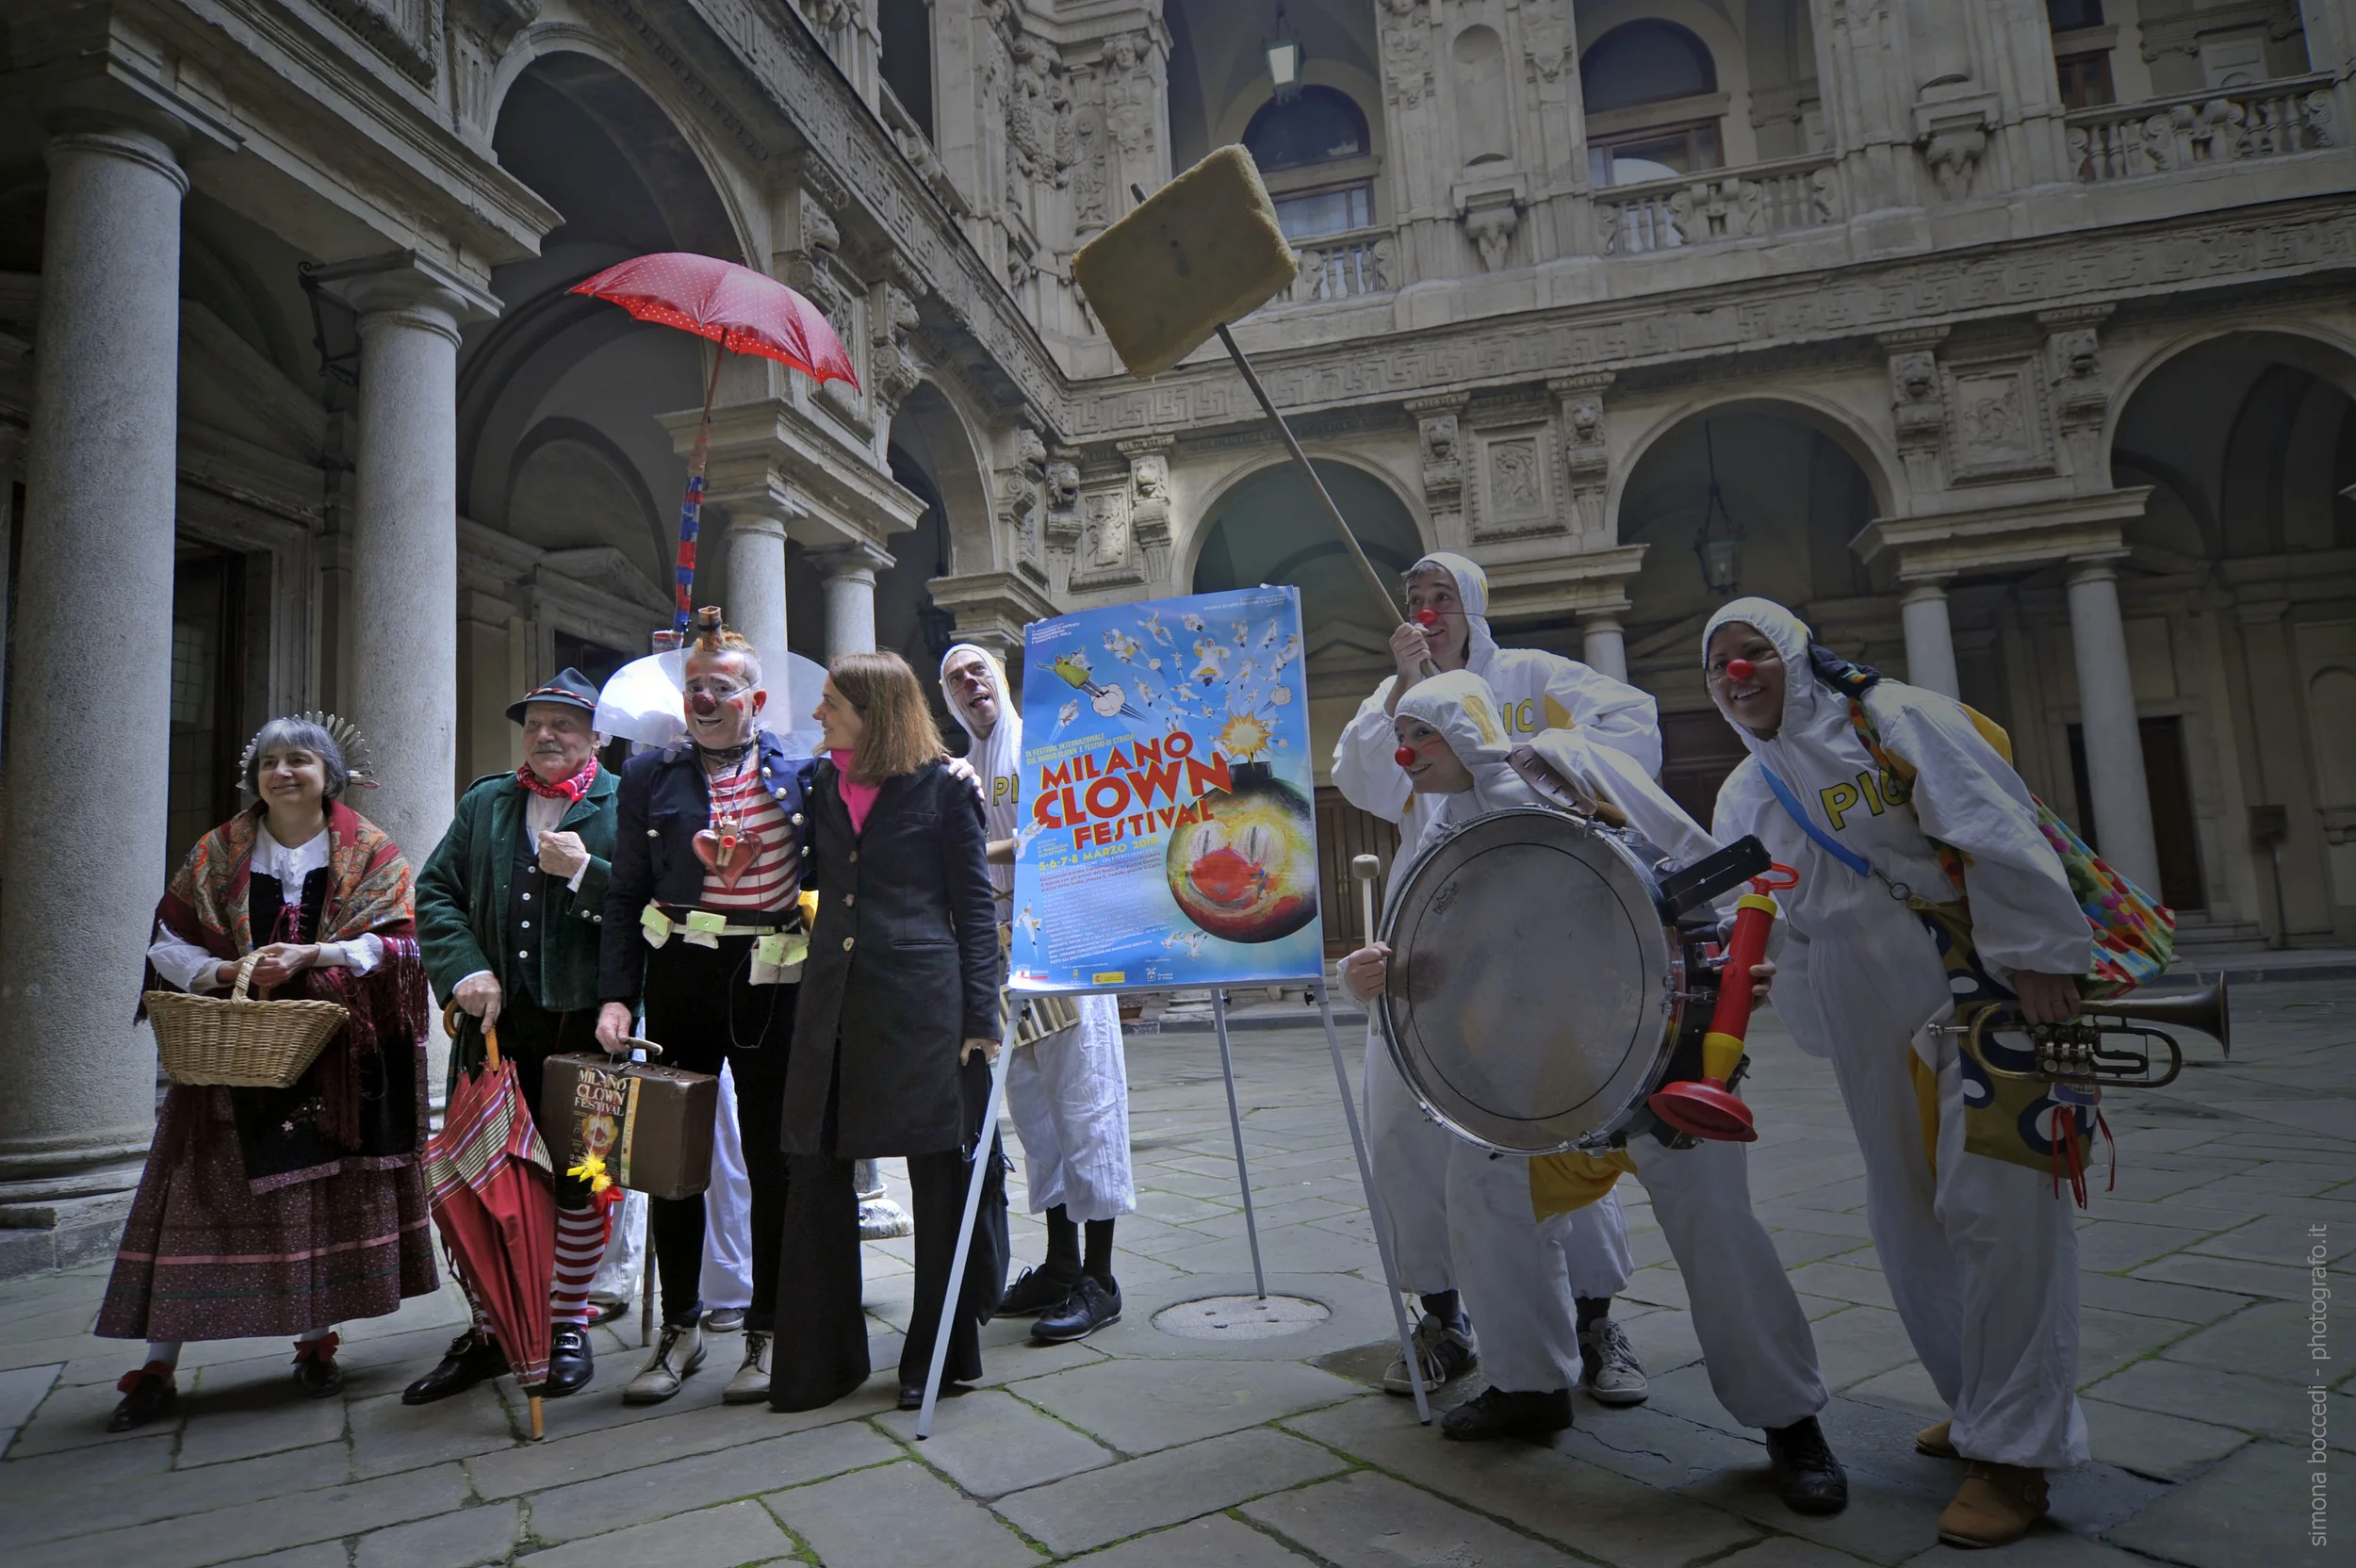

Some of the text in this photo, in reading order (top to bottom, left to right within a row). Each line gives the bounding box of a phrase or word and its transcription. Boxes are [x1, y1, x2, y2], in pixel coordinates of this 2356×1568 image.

[1497, 698, 1534, 736] IC
[1027, 757, 1039, 765] SUL
[1057, 748, 1078, 759] CLOWN
[1085, 740, 1105, 751] TEATRO
[1113, 733, 1136, 744] STRADA
[1034, 745, 1057, 757] FESTIVAL
[1059, 732, 1105, 750] INTERNAZIONALE
[1040, 731, 1194, 790] MILANO
[1033, 752, 1233, 829] CLOWN
[1073, 798, 1214, 850] FESTIVAL
[1083, 843, 1128, 861] MARZO
[1132, 836, 1159, 850] 2014
[574, 1096, 625, 1116] FESTIVAL
[576, 1084, 625, 1105] CLOWN
